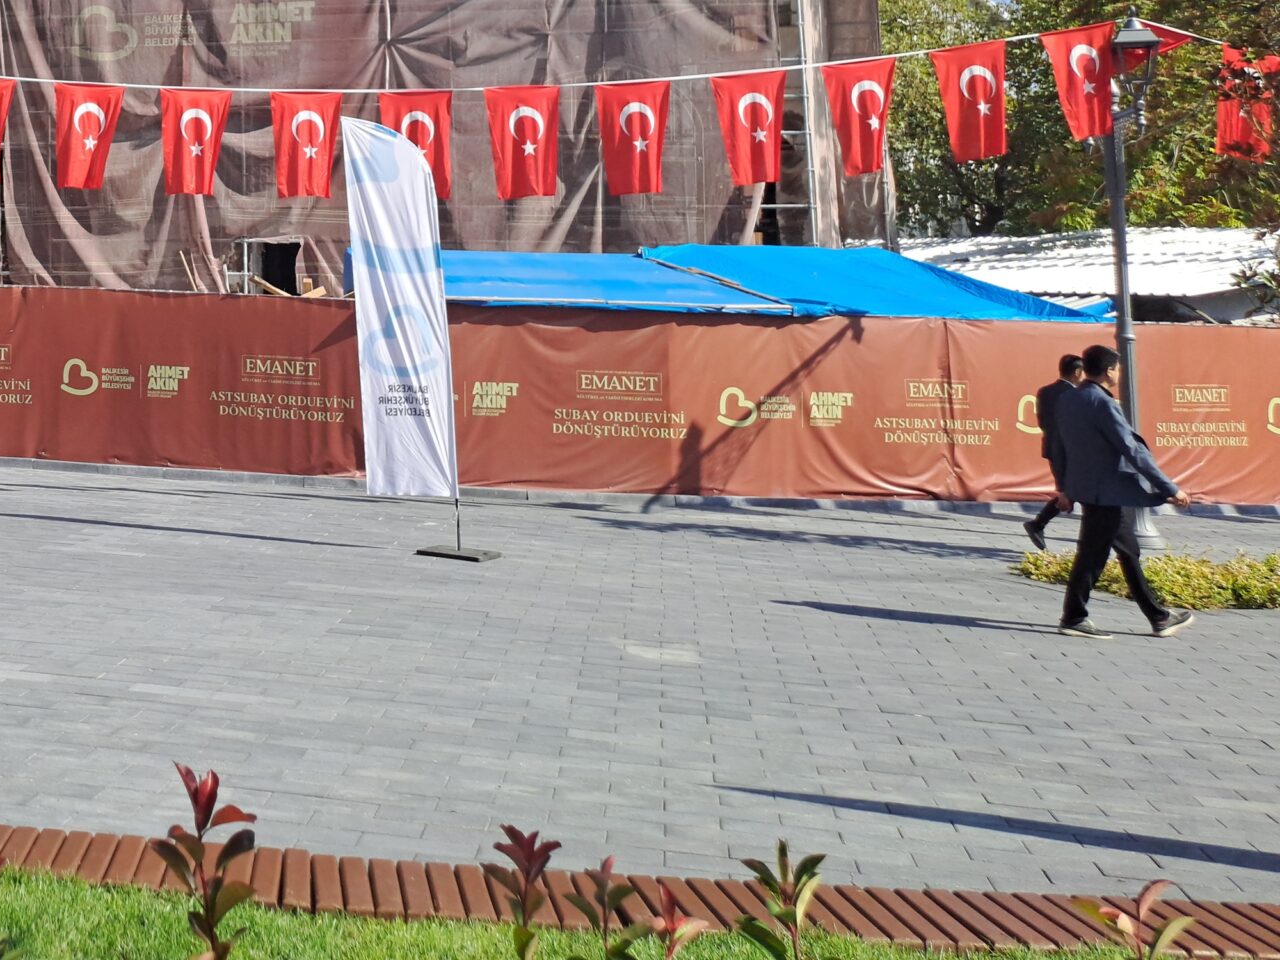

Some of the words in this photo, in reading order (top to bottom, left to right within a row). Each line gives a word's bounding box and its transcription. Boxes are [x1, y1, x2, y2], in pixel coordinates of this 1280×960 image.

[144, 14, 193, 24] BALIKESR
[230, 1, 315, 23] AHMET
[230, 22, 292, 44] AKIN
[144, 37, 197, 47] BELEDİESİ
[147, 365, 190, 379] AHMET
[245, 358, 317, 377] EMANET
[147, 378, 179, 391] AKIN
[472, 381, 520, 396] AHMET
[580, 373, 659, 392] EMANET
[209, 390, 275, 405] ASTSUBAY
[278, 394, 355, 410] ORDUEVİ'Nİ
[472, 395, 507, 409] AKIN
[809, 391, 854, 406] AHMET
[1174, 388, 1228, 403] EMANET
[219, 403, 345, 423] DÖNÜŞTÜRÜYORUZ
[554, 408, 599, 421] SUBAY
[602, 409, 686, 425] ORDUEVİ'Nİ
[809, 405, 842, 418] AKIN
[552, 421, 688, 439] DÖNÜŞTÜRÜYORUZ
[873, 416, 937, 429] ASTSUBAY
[1156, 422, 1191, 433] SUBAY
[884, 430, 991, 445] DÖNÜŞTÜRYORUZ
